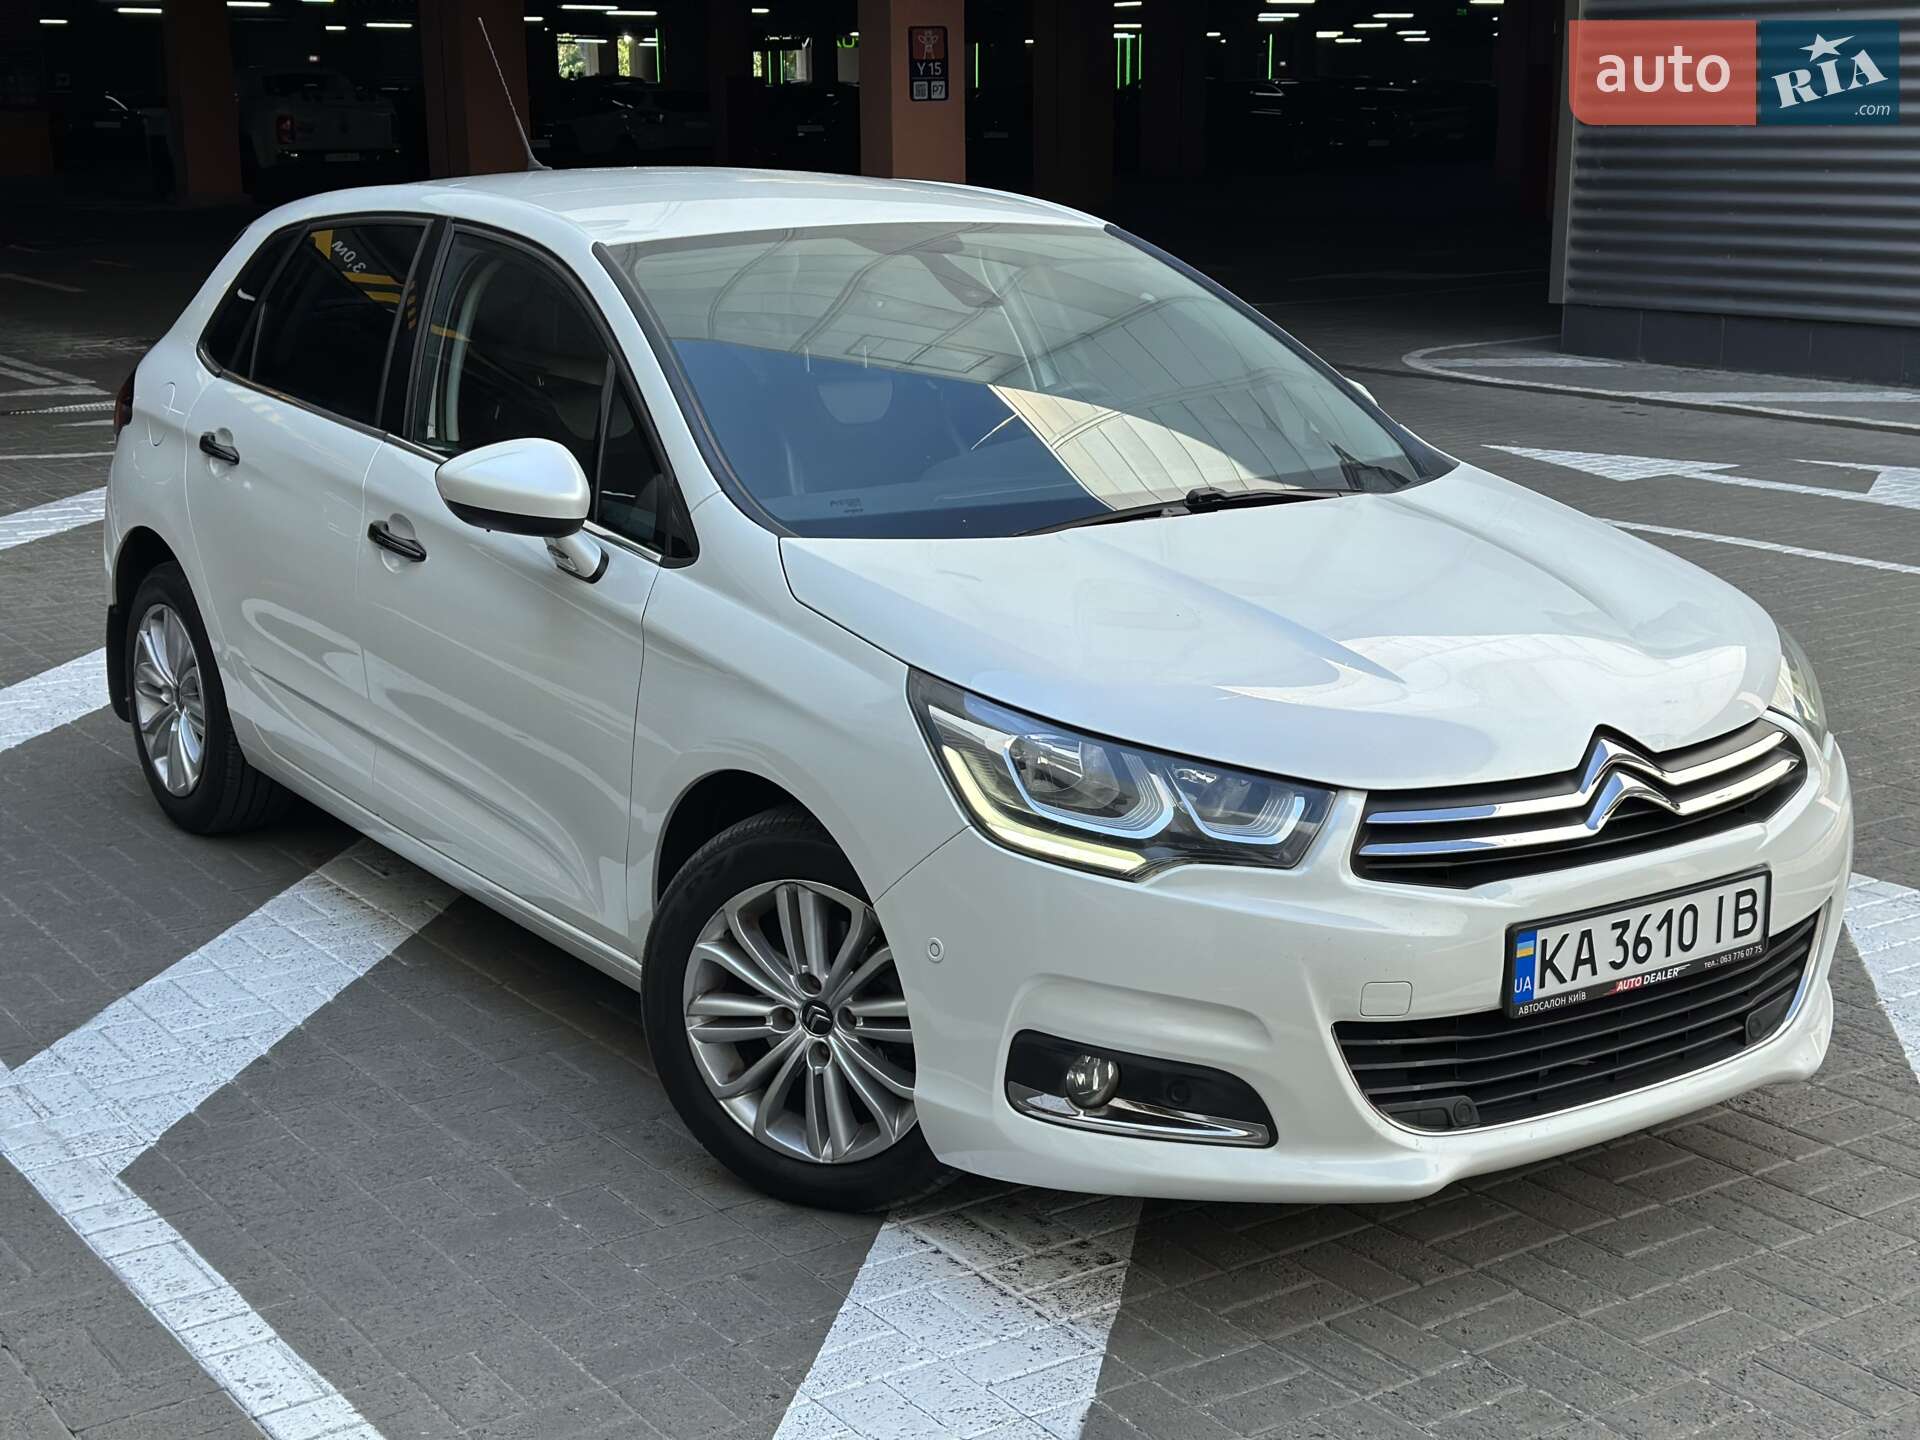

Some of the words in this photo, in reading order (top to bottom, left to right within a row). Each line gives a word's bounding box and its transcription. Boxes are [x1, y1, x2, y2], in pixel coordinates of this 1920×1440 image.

[916, 62, 926, 76] Y
[928, 62, 942, 76] 15
[1538, 929, 1598, 990] KA
[1608, 903, 1699, 970] 3610
[1715, 888, 1758, 944] IB
[1720, 953, 1732, 964] 063
[1733, 950, 1745, 960] 776
[1745, 947, 1754, 957] 07
[1754, 944, 1763, 953] 75
[1514, 975, 1532, 993] UA
[1615, 976, 1643, 993] AUTO
[1643, 967, 1680, 985] DEALER
[1518, 995, 1567, 1016] АВТОСАЛОН
